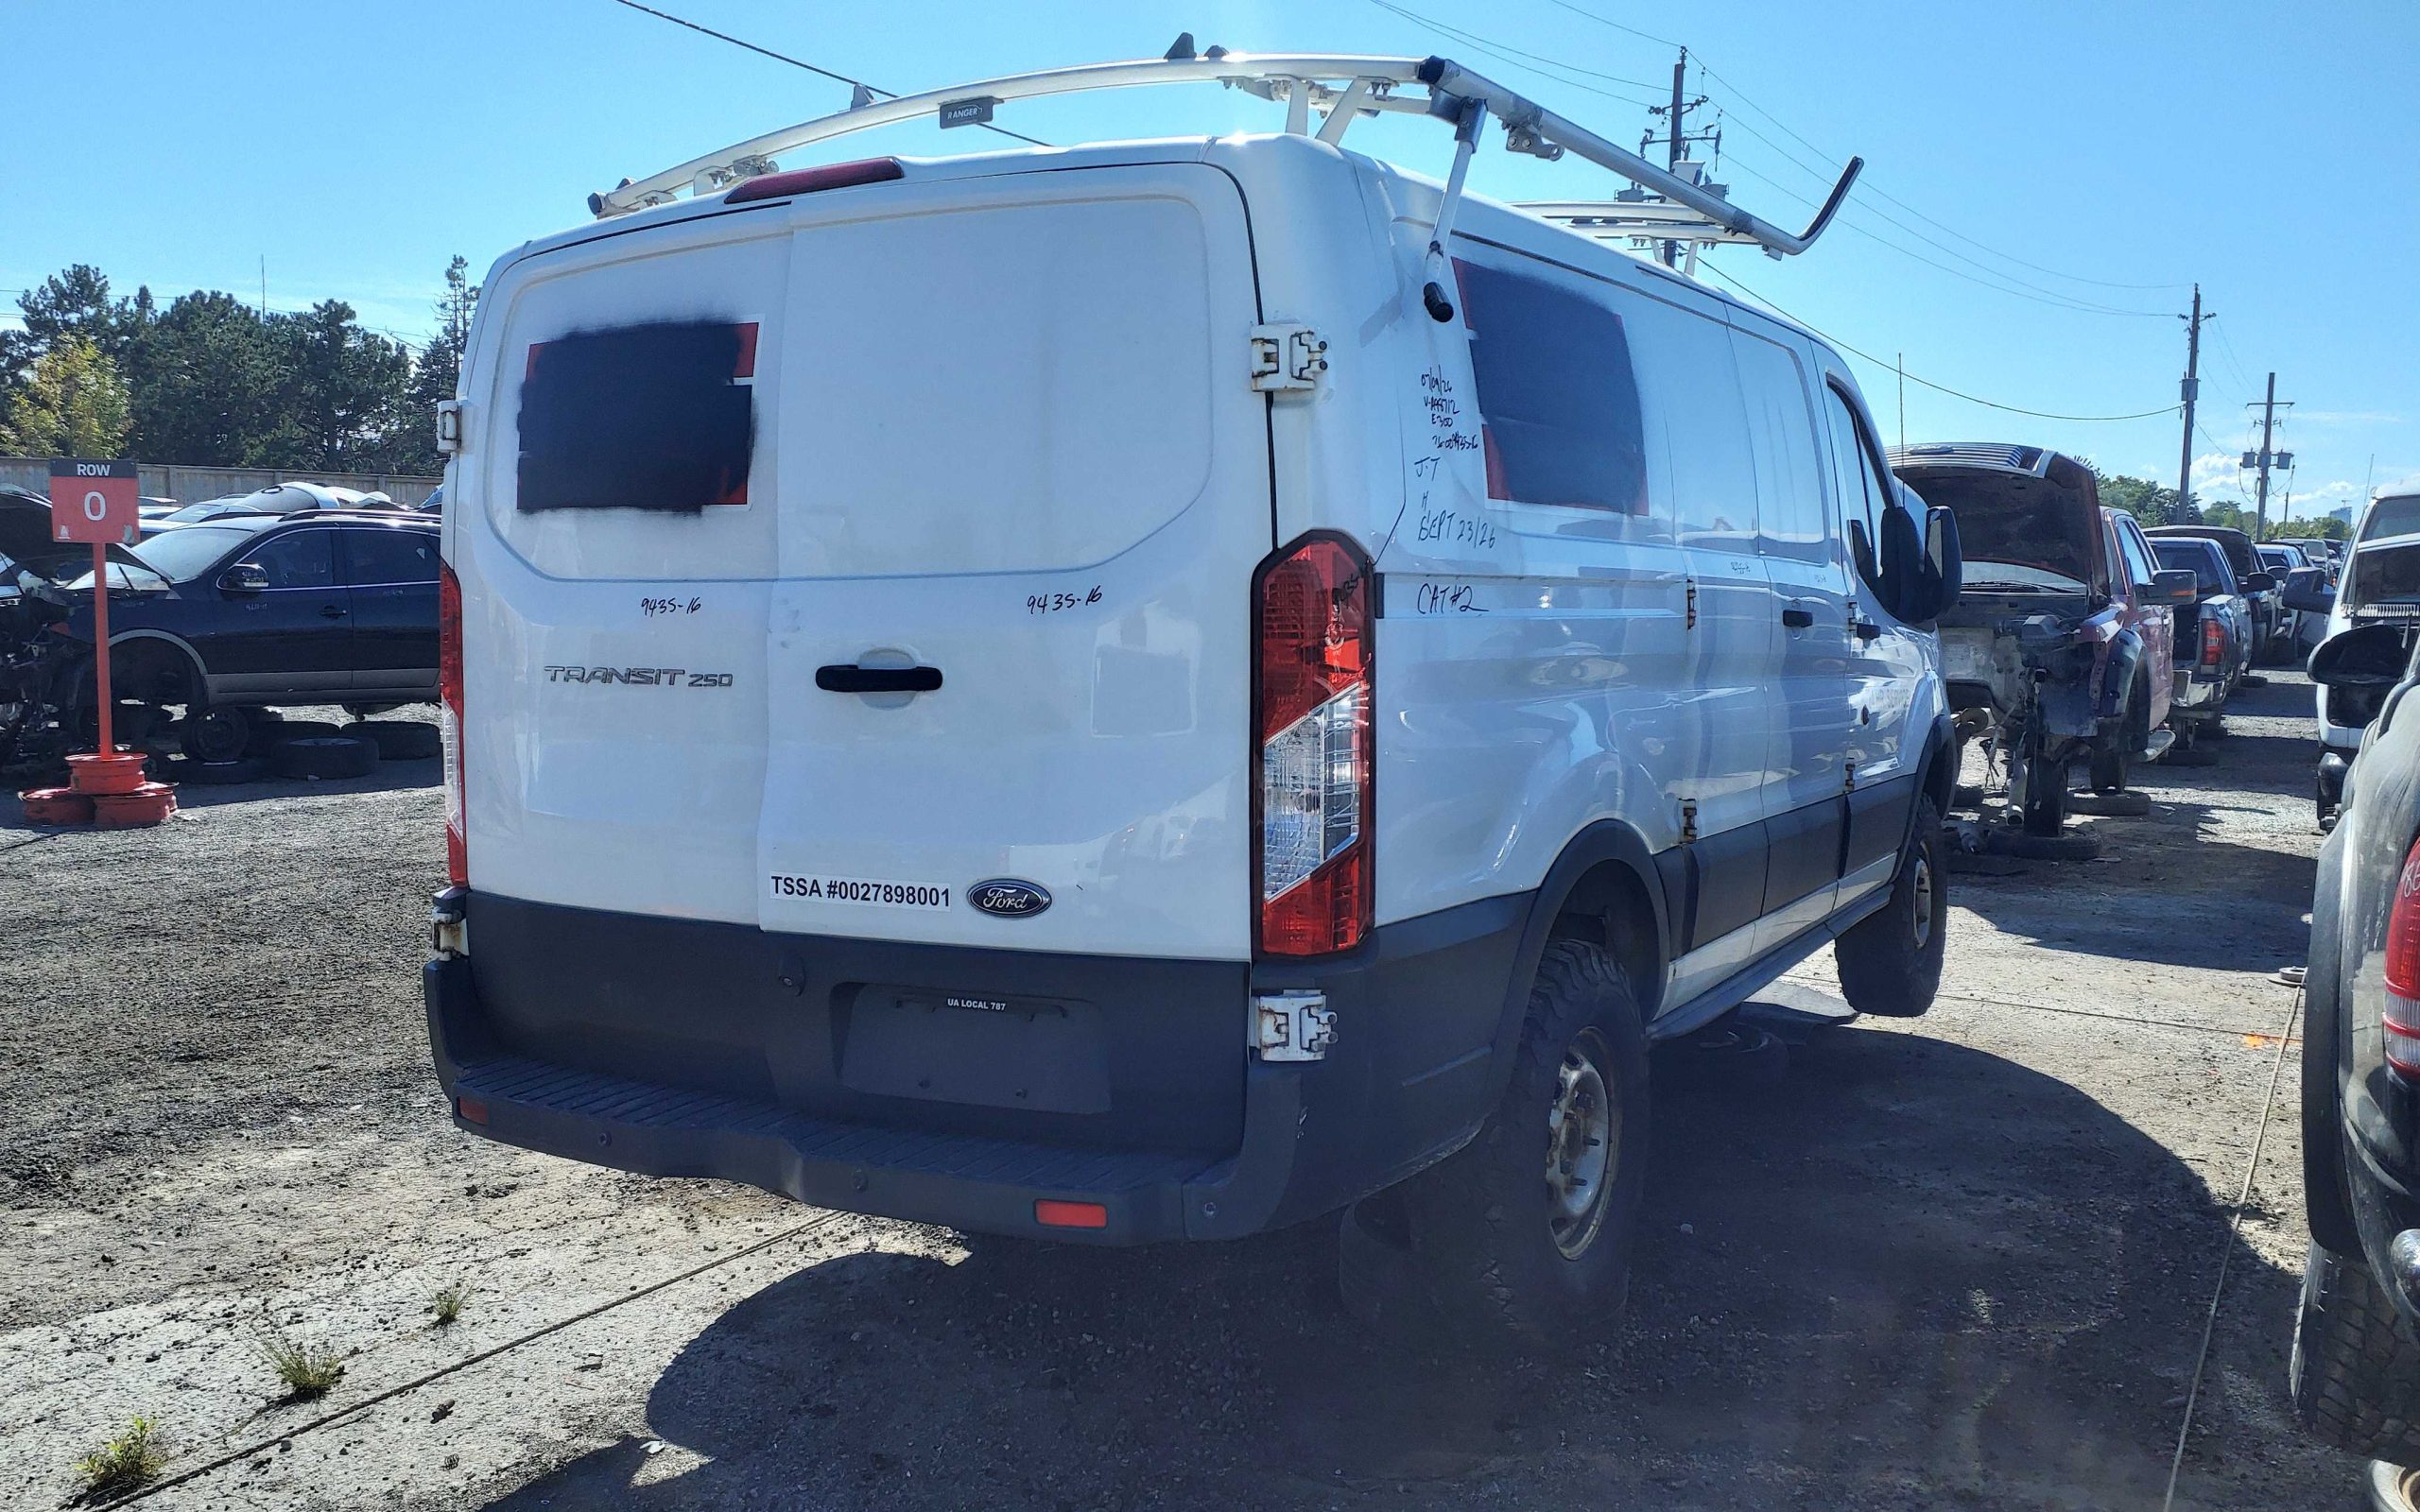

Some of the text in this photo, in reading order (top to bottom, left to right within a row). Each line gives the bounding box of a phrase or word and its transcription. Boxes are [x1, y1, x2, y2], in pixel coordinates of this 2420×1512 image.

[947, 108, 978, 119] RANGER
[77, 463, 111, 476] ROW
[544, 665, 734, 688] TRANSIT 250
[771, 875, 951, 907] TSSA #0027898001
[982, 887, 1028, 910] Ford
[947, 998, 1007, 1011] UA LOCAL 787
